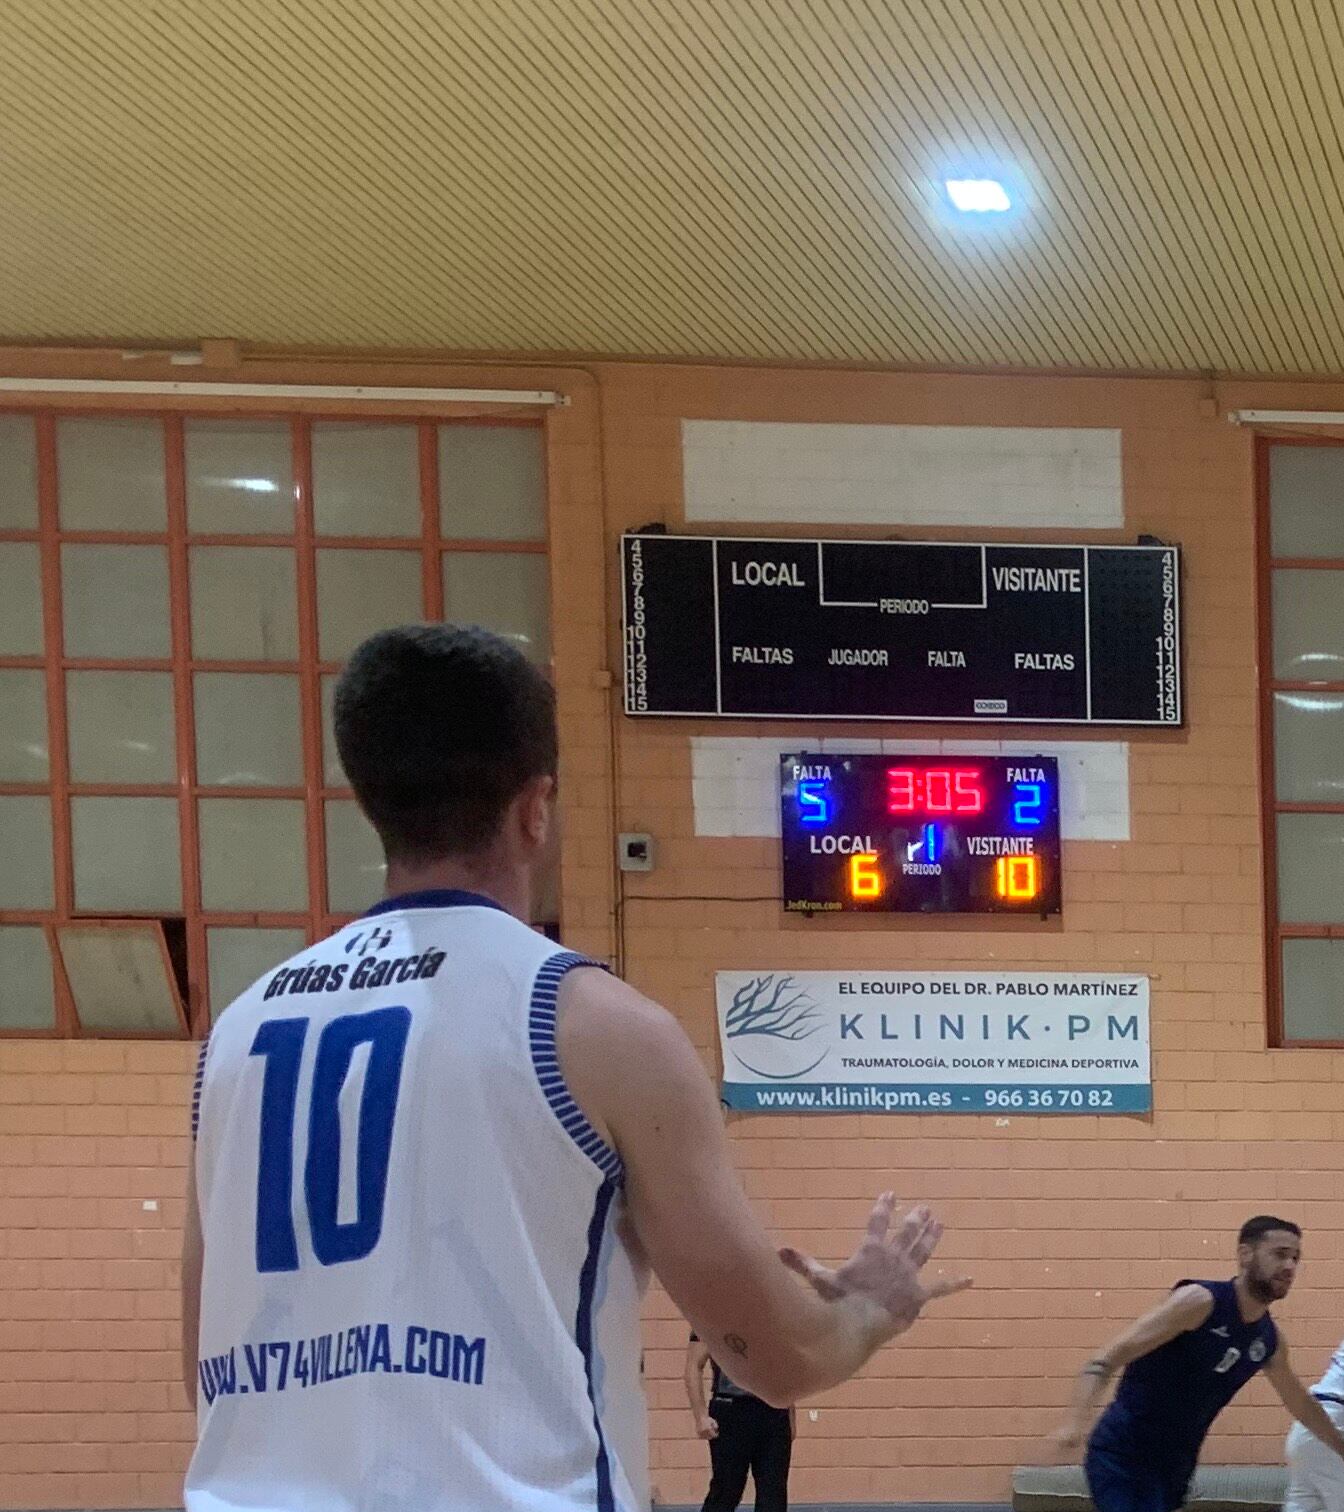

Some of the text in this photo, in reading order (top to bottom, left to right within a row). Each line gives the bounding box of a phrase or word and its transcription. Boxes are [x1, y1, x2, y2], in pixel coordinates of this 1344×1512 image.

[631, 539, 642, 554] 4
[632, 554, 643, 568] 5
[1162, 552, 1172, 566] 4
[633, 568, 644, 582] 6
[732, 561, 805, 586] LOCAL
[992, 567, 1081, 592] VISITANTE
[1163, 566, 1173, 580] 5
[632, 582, 644, 596] 7
[1163, 580, 1173, 594] 6
[634, 596, 645, 610] 8
[880, 599, 929, 614] PERIODO
[1163, 594, 1173, 608] 7
[634, 610, 645, 625] 9
[1163, 608, 1174, 621] 8
[627, 625, 646, 640] 10
[1163, 622, 1174, 636] 9
[627, 640, 645, 654] 11
[1156, 636, 1174, 651] 10
[628, 654, 647, 668] 12
[732, 647, 793, 664] FALTAS
[828, 649, 888, 666] JUGADOR
[928, 651, 966, 667] FALTA
[1014, 653, 1075, 670] FALTAS
[1156, 651, 1174, 665] 11
[628, 669, 647, 682] 13
[1156, 665, 1174, 679] 12
[628, 683, 647, 696] 14
[1156, 679, 1175, 693] 13
[629, 697, 648, 711] 15
[1157, 693, 1175, 707] 14
[1157, 707, 1176, 720] 15
[793, 766, 832, 780] FALTA
[1007, 768, 1046, 782] FALTA
[889, 771, 980, 811] 3:05
[802, 783, 826, 821] 5
[1014, 785, 1041, 824] 2
[810, 836, 877, 854] LOCAL
[967, 837, 1034, 856] VISITANTE
[851, 855, 879, 896] 6
[902, 863, 941, 875] PERIODO
[996, 857, 1035, 897] 10
[349, 947, 447, 991] García
[839, 980, 1138, 996] EL EQUIPO DEL DR. PABLO MARTÍNEZ
[842, 1056, 1139, 1069] TRAUMATOLOGÍA, DOLOR Y MEDICINA DEPORTIVA
[756, 1087, 952, 1110] www.klinikpm.es
[985, 1090, 1023, 1106] 966
[1027, 1090, 1052, 1106] 36
[1059, 1090, 1084, 1106] 70
[1088, 1090, 1113, 1106] 82
[248, 1005, 413, 1273] 10
